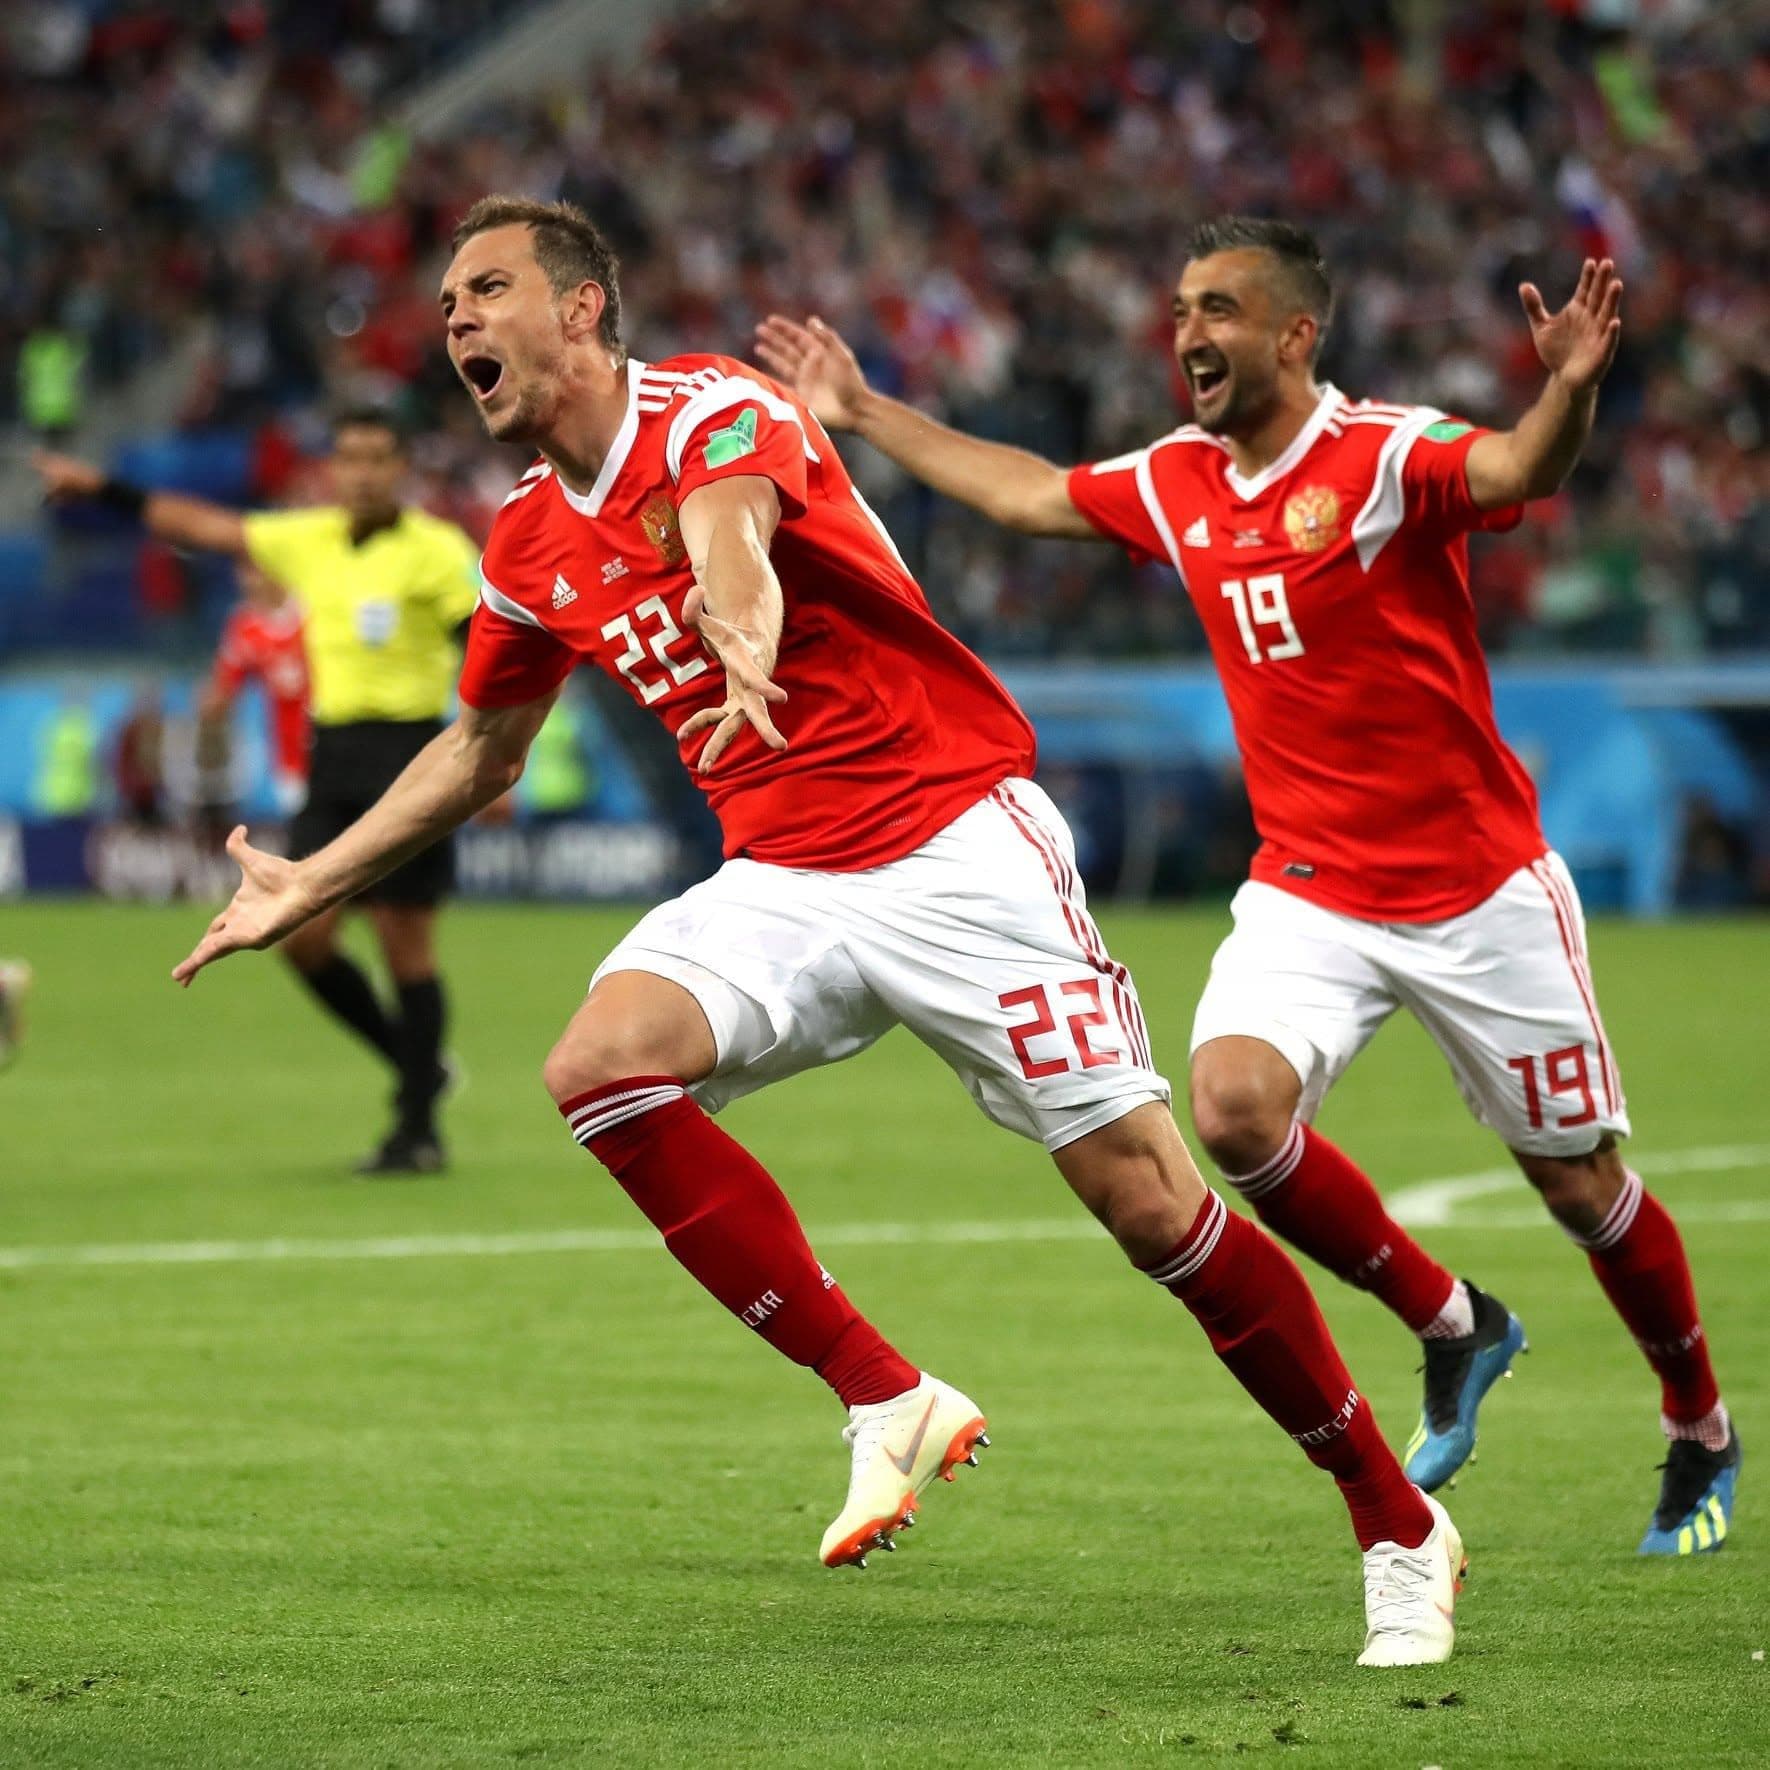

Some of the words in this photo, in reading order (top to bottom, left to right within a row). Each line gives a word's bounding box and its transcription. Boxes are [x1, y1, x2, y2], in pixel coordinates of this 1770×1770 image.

[601, 594, 708, 705] 22
[1220, 573, 1305, 664] 19
[998, 978, 1120, 1080] 22
[1507, 1044, 1597, 1129] 19
